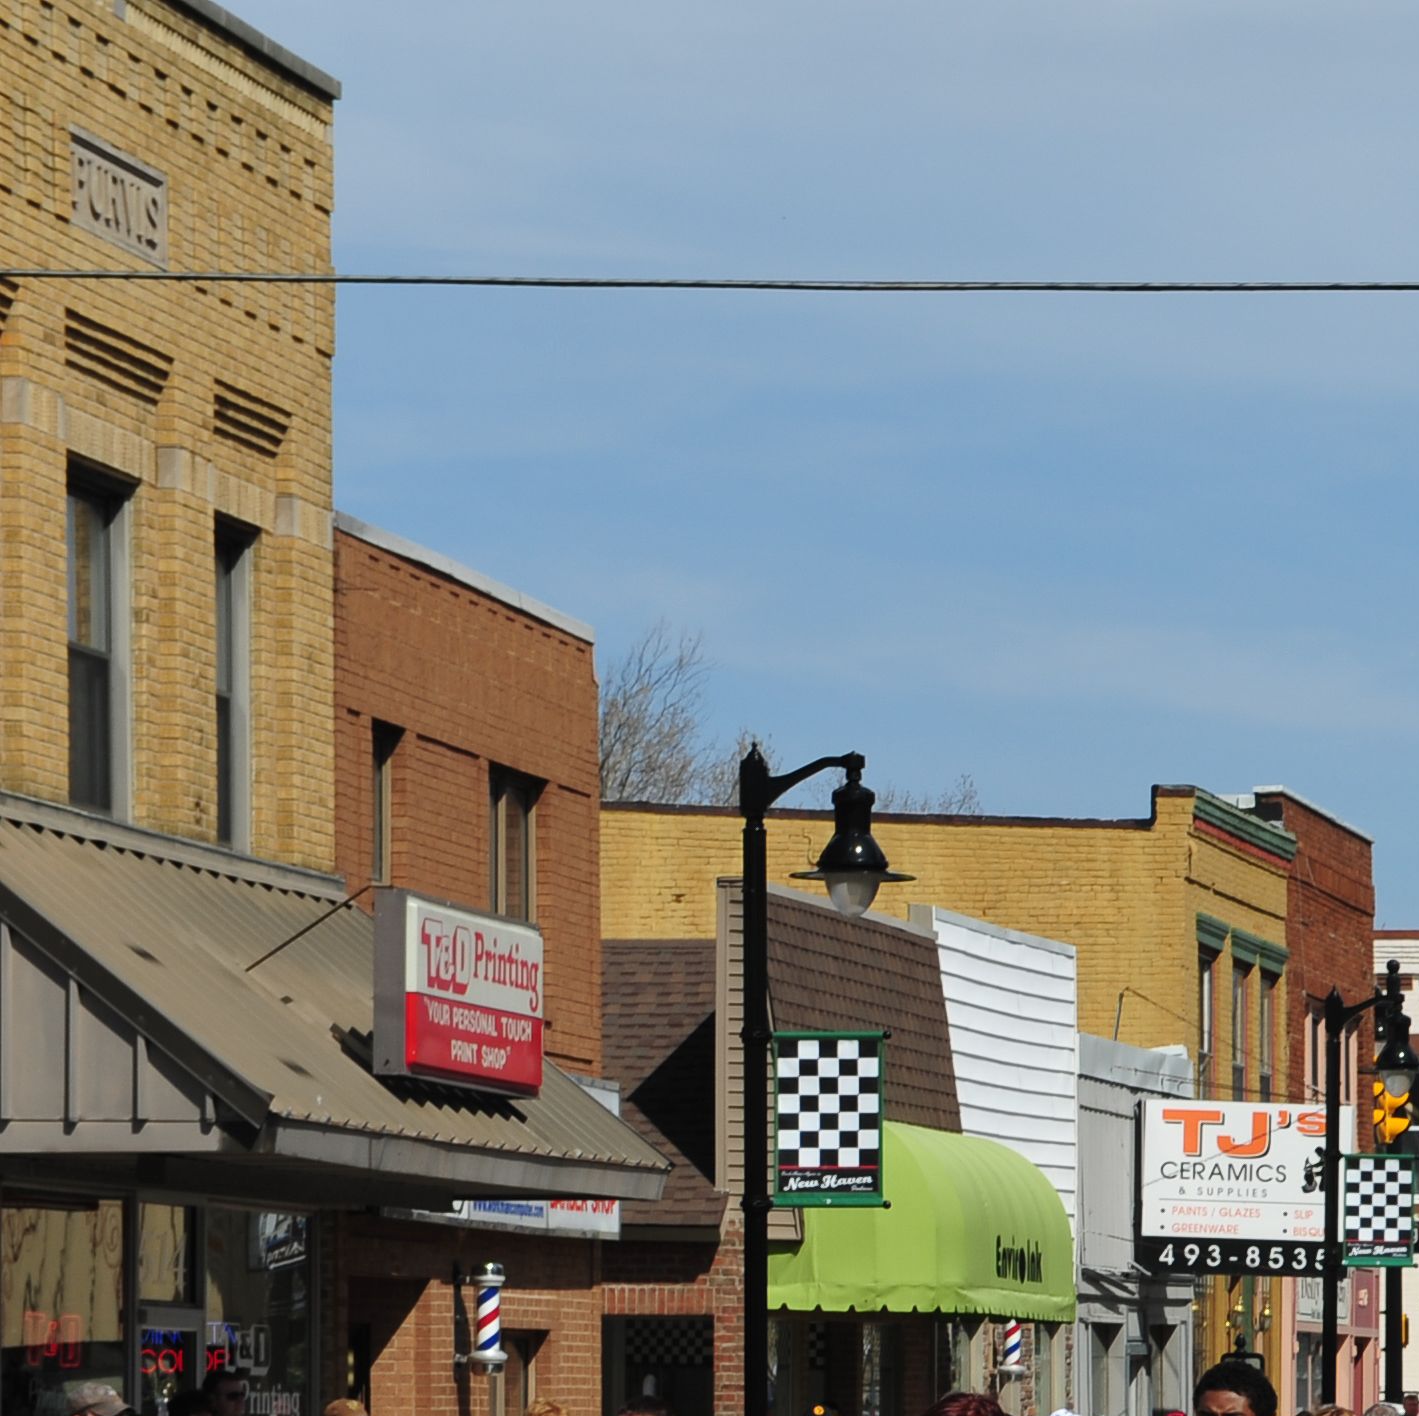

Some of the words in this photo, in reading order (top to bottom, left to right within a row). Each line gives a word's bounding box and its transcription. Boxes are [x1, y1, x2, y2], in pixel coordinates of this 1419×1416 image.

[421, 917, 472, 996] T&D
[473, 931, 539, 1013] Printing
[452, 1006, 498, 1038] PERSONAL
[500, 1016, 532, 1043] TOUCH
[451, 1039, 478, 1065] PRINT
[1160, 1160, 1288, 1184] CERAMICS
[783, 1177, 820, 1192] New
[820, 1174, 873, 1189] Haven
[1178, 1186, 1187, 1196] &
[1196, 1186, 1269, 1199] SUPPLIES
[1171, 1205, 1209, 1217] PAINTS
[1218, 1207, 1262, 1219] GLAZES
[1294, 1209, 1314, 1220] SLIP
[1171, 1222, 1241, 1235] GREENWARE
[1348, 1246, 1373, 1257] New
